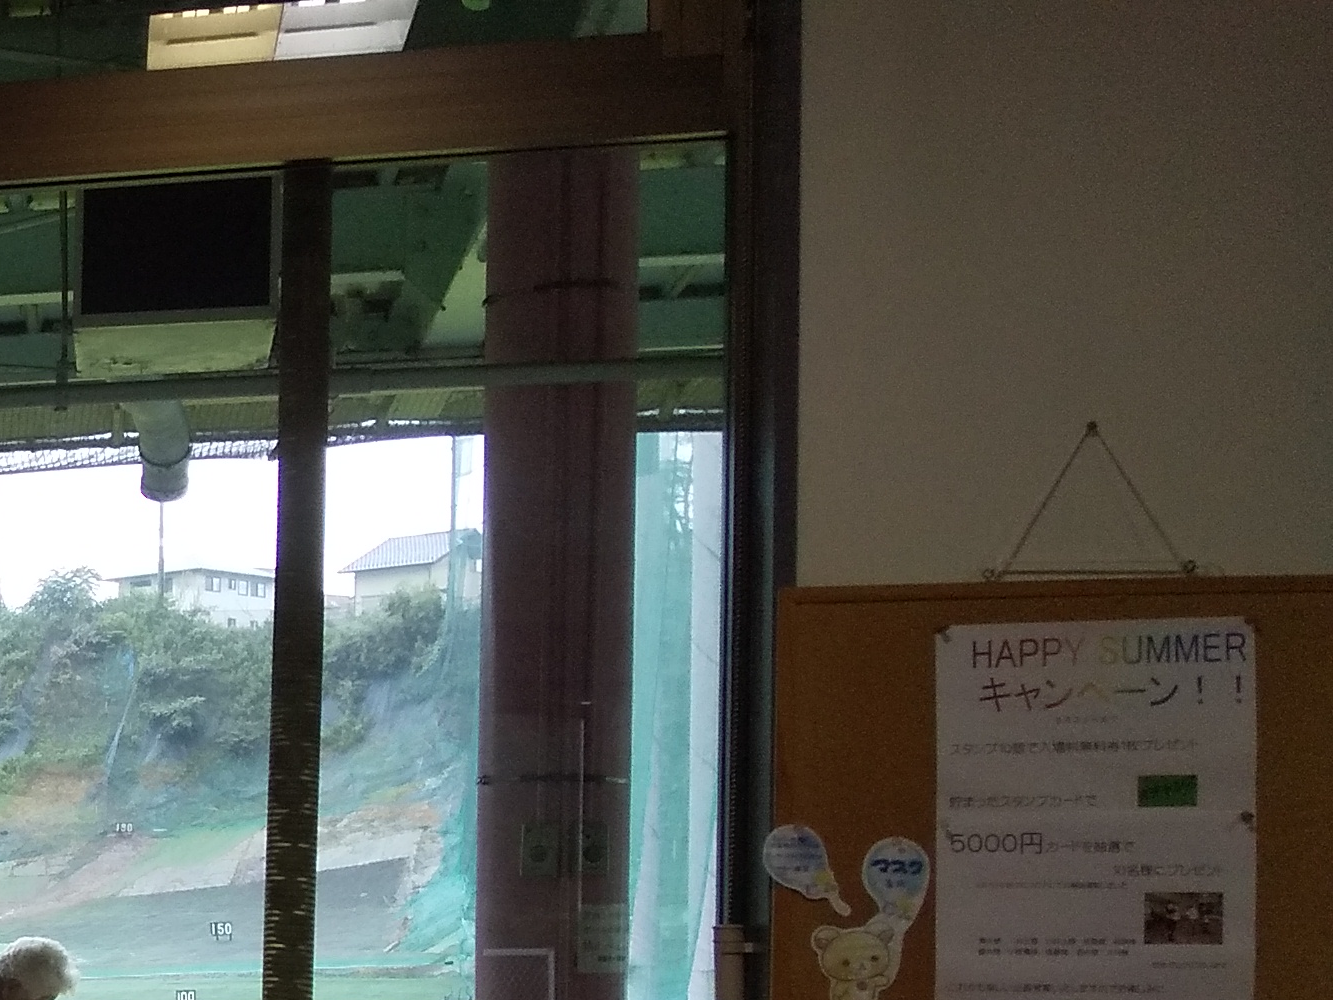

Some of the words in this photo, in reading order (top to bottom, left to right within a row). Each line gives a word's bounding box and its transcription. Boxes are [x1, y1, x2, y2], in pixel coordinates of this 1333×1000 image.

[971, 637, 1084, 669] HAPPY
[1098, 632, 1247, 665] SUMMER
[211, 922, 232, 935] 150
